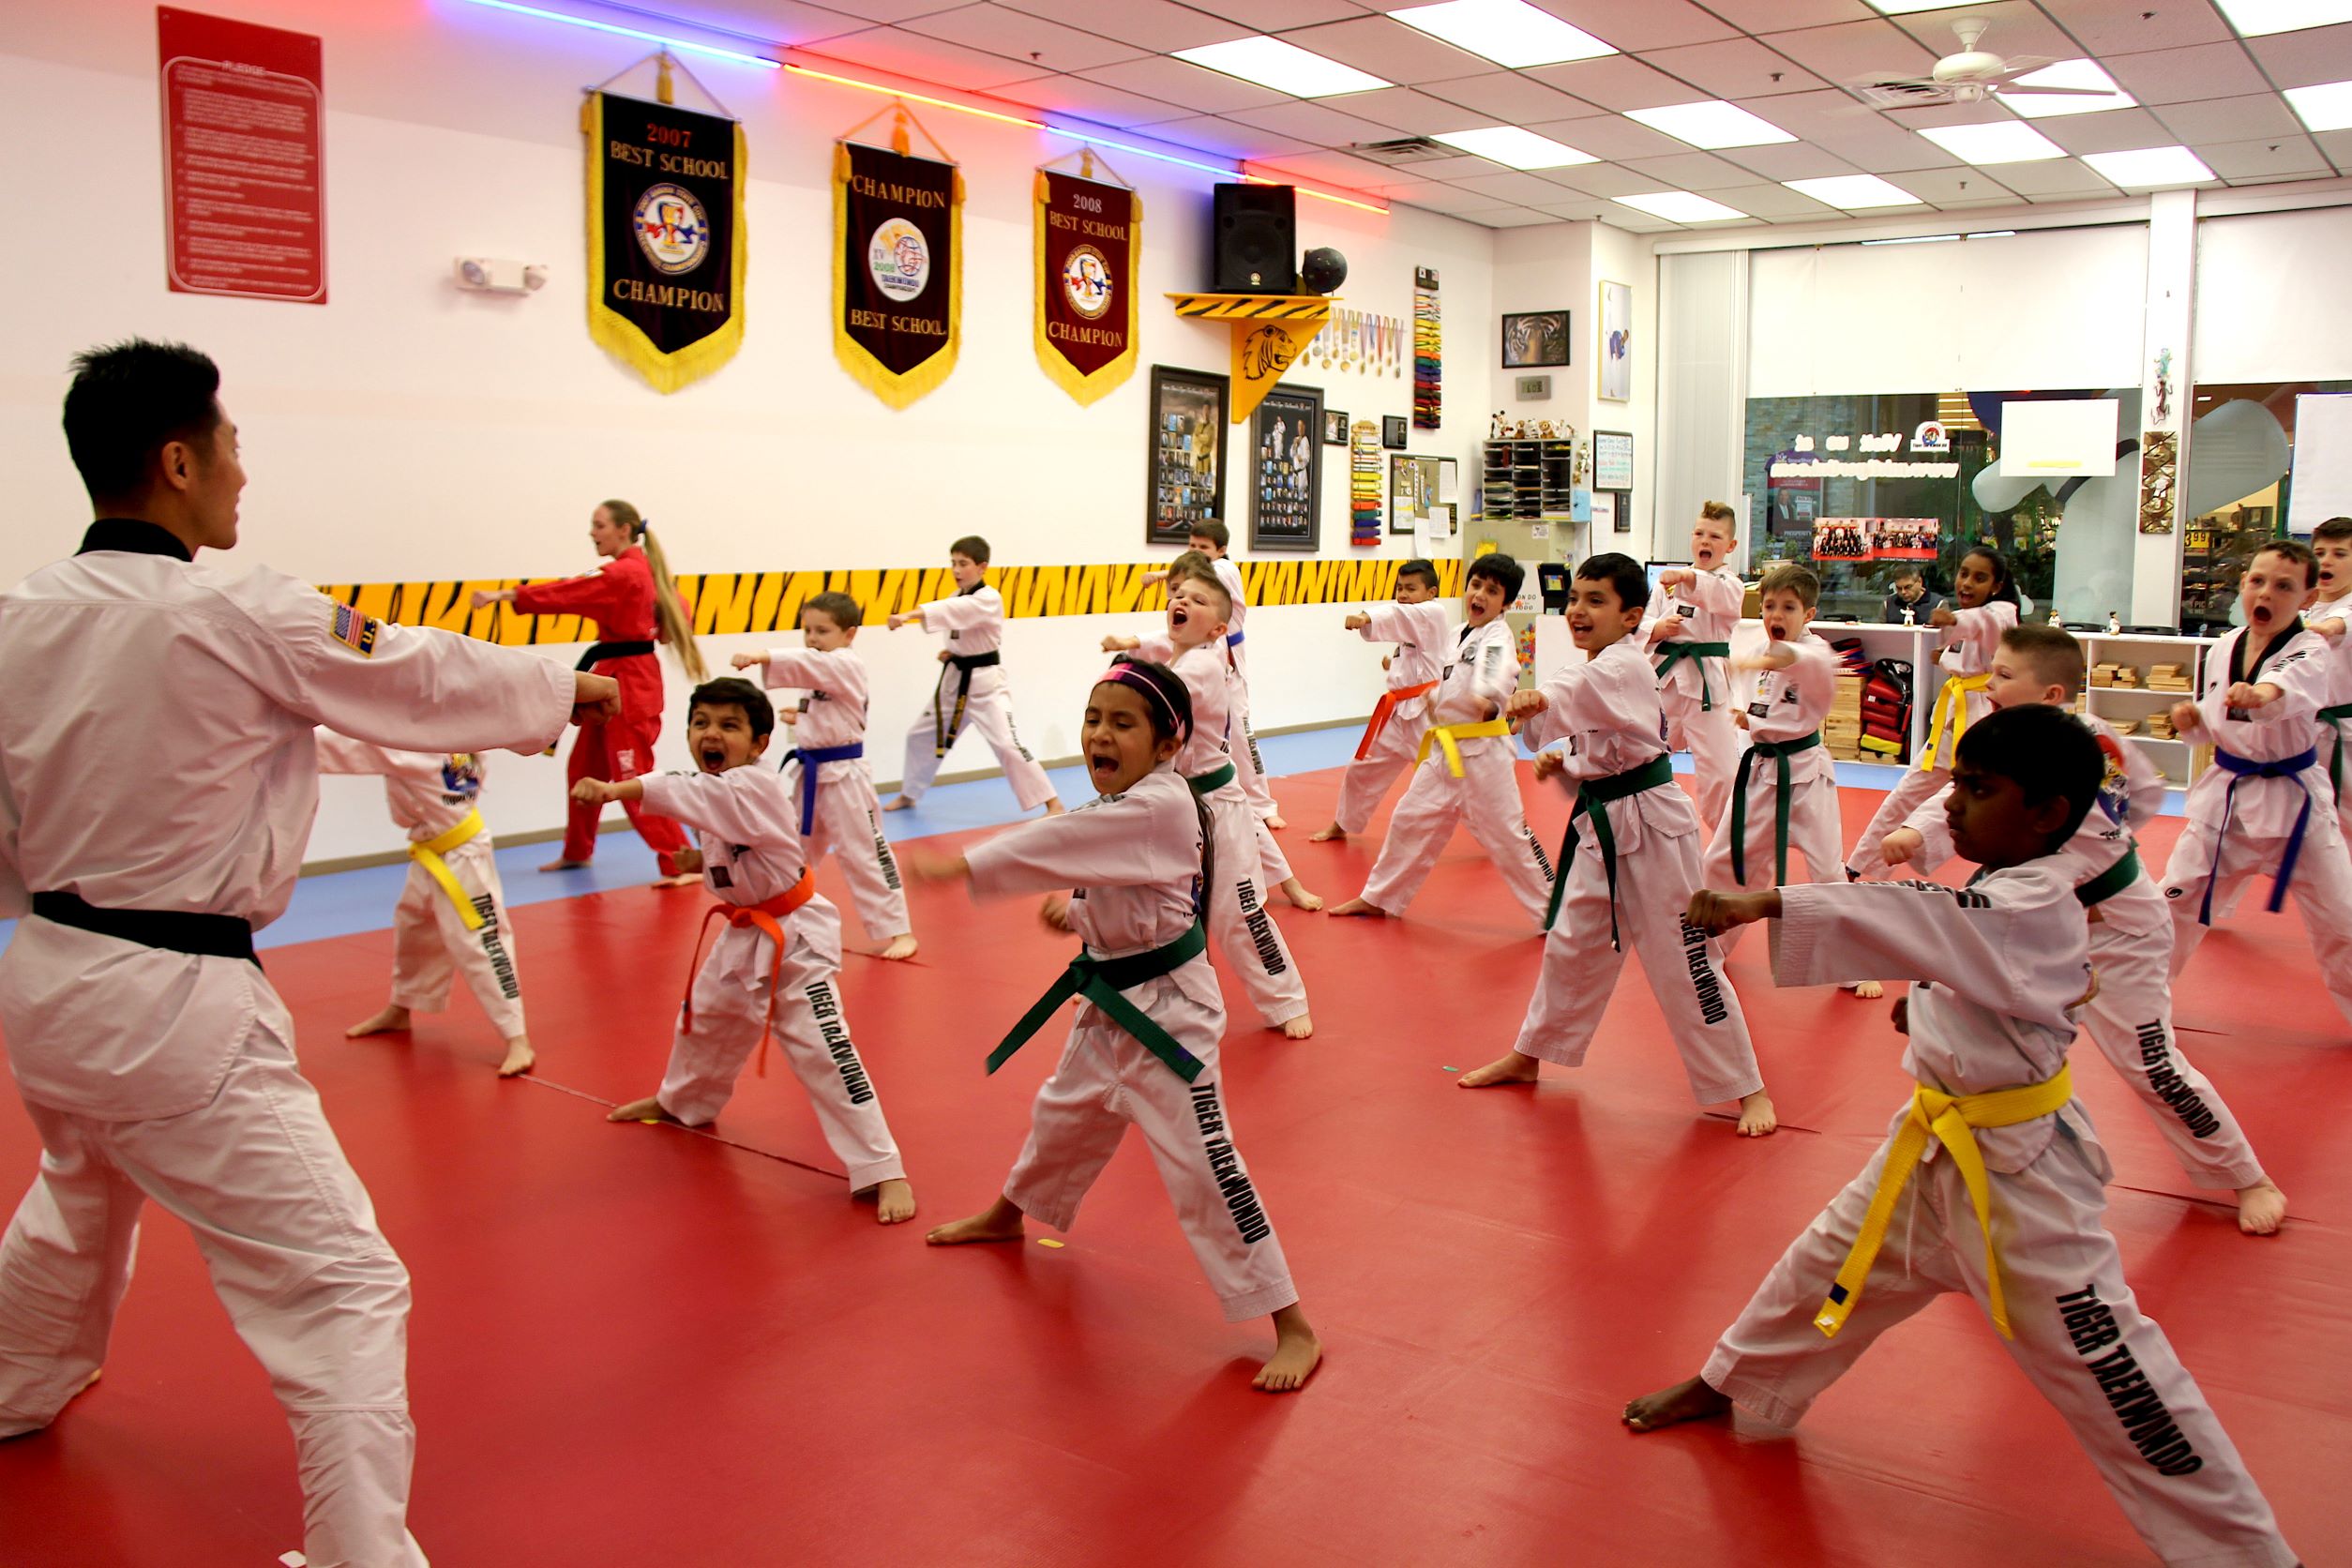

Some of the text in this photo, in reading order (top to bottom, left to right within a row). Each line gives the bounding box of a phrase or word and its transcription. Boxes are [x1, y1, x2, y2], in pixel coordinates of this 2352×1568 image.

[646, 123, 692, 148] 2007
[611, 141, 729, 179] BEST SCHOOL
[852, 174, 945, 208] CHAMPION
[1073, 193, 1103, 213] 2008
[1050, 210, 1128, 241] BEST SCHOOL
[612, 279, 724, 312] CHAMPION
[851, 309, 947, 335] BEST SCHOOL
[1048, 321, 1123, 347] CHAMPION
[1236, 877, 1287, 975] TIGER TAEKWONDO
[481, 928, 520, 1000] TAEKWONDO
[1685, 943, 1728, 1025] TAEKWONDO
[805, 981, 874, 1105] TIGER TAEKWONDO
[2135, 1018, 2221, 1138] TIGER TAEKWONDO
[1189, 1082, 1271, 1244] TIGER TAEKWONDO
[2056, 1283, 2203, 1476] TIGER TAEKWONDO
